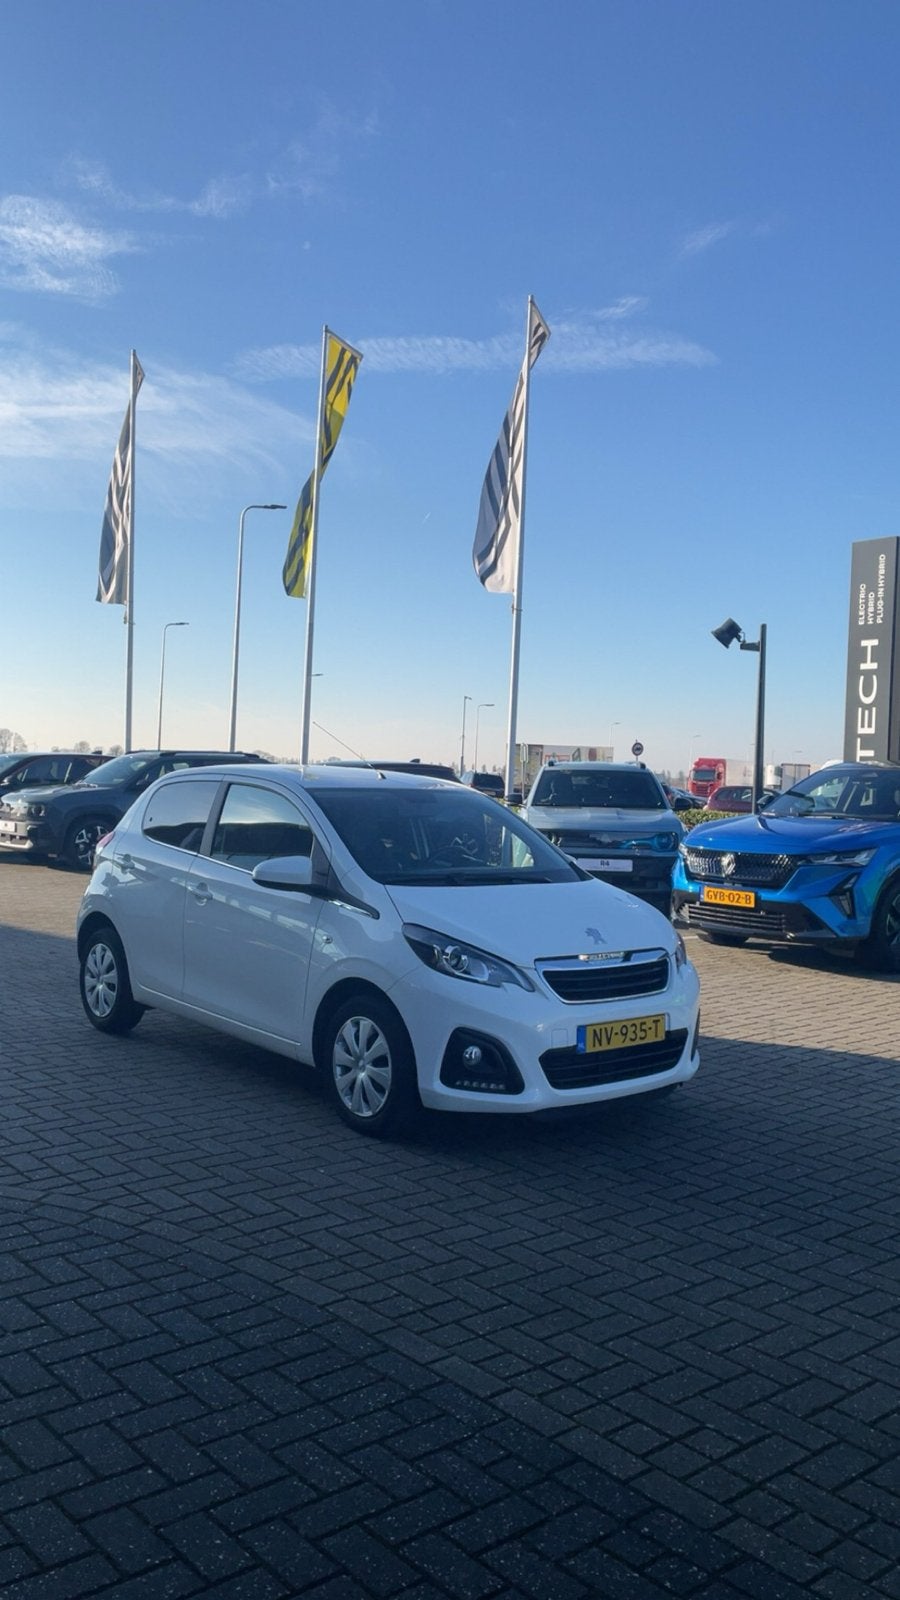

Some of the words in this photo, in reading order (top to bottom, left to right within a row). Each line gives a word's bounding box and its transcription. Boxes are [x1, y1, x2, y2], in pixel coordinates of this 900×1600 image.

[878, 554, 886, 587] HYBRID
[867, 592, 875, 624] HYBRID
[876, 588, 885, 624] PLUG-IN
[856, 639, 879, 762] TECH
[600, 859, 610, 867] R4
[592, 1019, 661, 1048] NV-935-T
